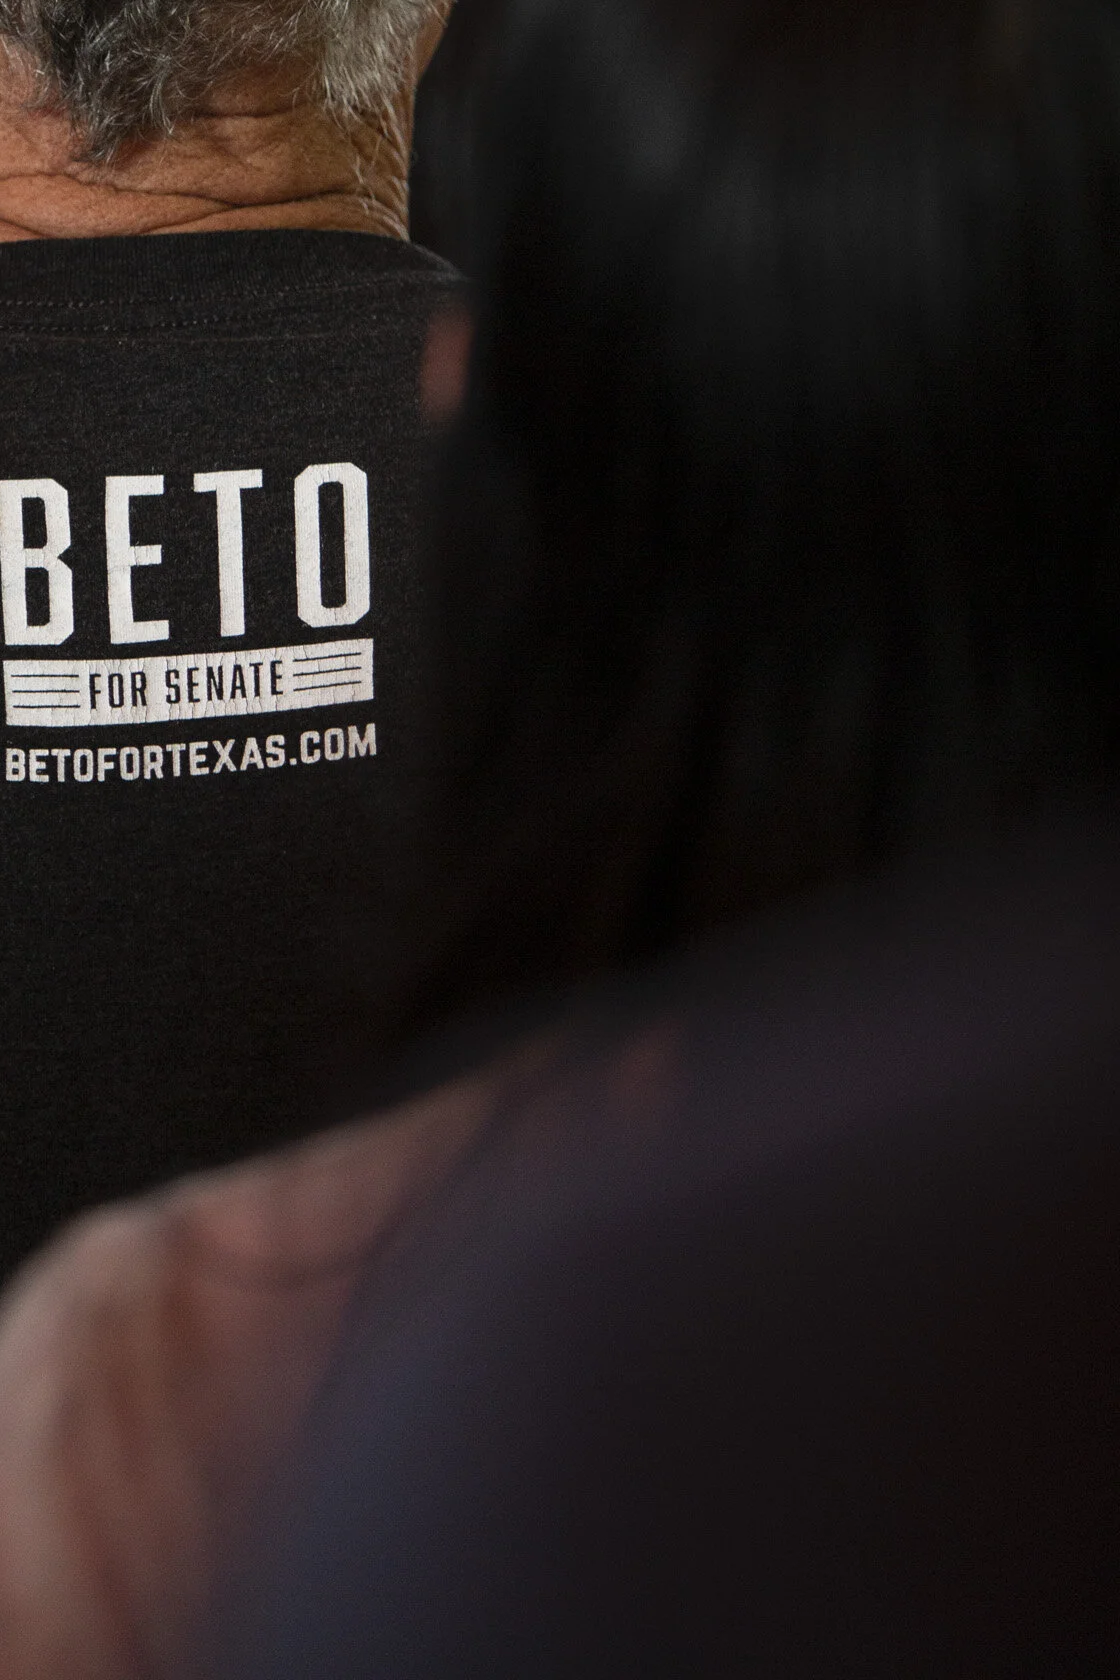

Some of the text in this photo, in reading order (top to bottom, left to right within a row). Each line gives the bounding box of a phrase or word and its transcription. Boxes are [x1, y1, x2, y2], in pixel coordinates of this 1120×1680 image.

[89, 660, 285, 709] FOR SENATE
[5, 723, 377, 782] BETOFORTEXAS.COM
